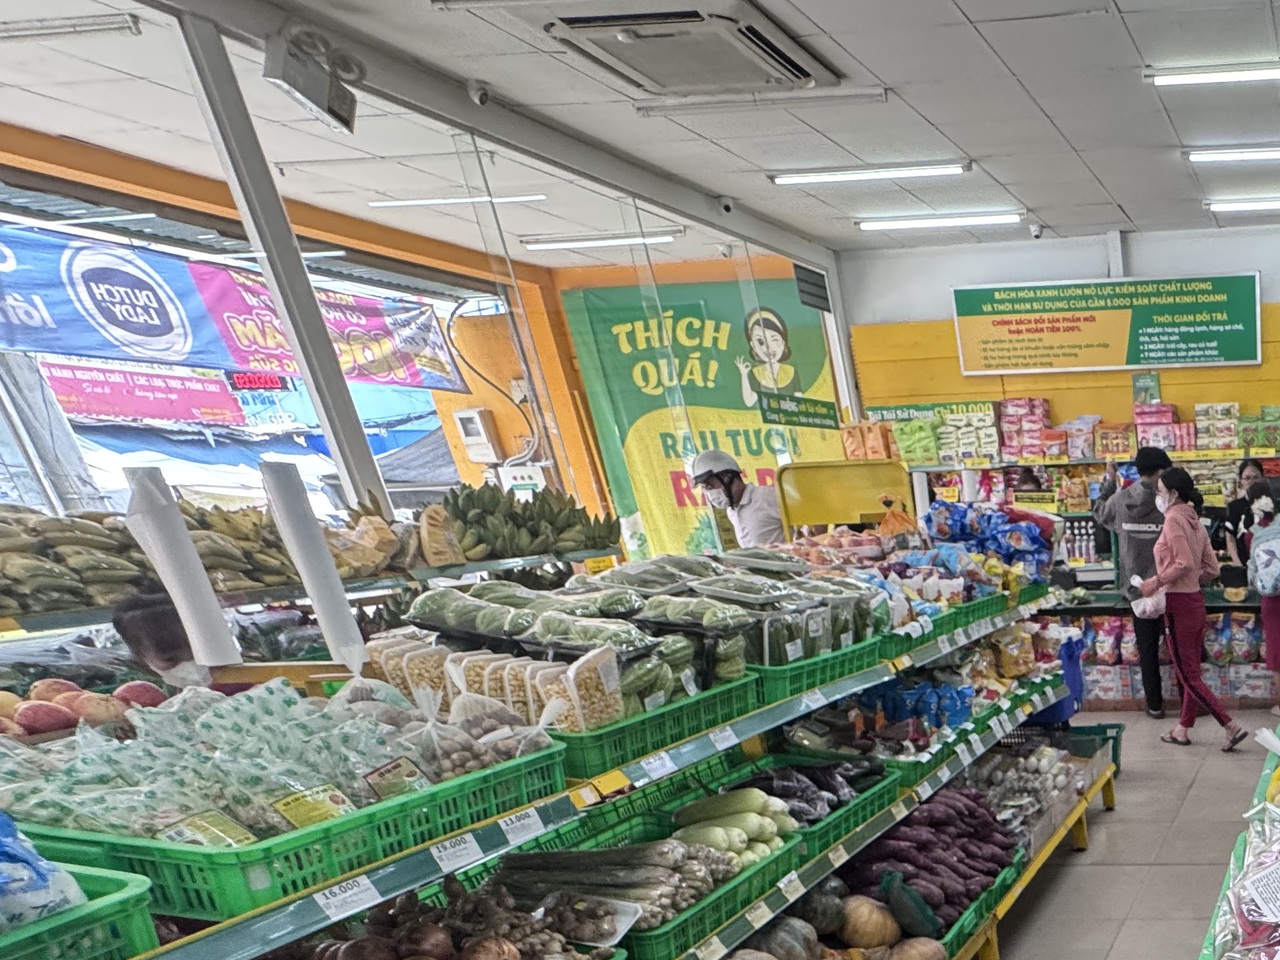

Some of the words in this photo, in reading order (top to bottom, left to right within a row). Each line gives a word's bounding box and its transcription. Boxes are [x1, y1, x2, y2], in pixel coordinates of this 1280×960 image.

[994, 289, 1016, 300] BÁCH
[1017, 287, 1035, 298] HÓA
[1036, 287, 1059, 297] XANH
[1060, 285, 1081, 296] LUÔN
[1098, 284, 1114, 295] LỰC
[1115, 283, 1136, 294] KIỂM
[1137, 282, 1157, 293] SOÁT
[1159, 281, 1181, 292] CHẤT
[1183, 281, 1212, 292] LƯỢNG
[982, 302, 994, 312] VÀ
[995, 301, 1013, 312] THỜI
[1014, 302, 1032, 313] HẠN
[1045, 300, 1068, 311] DỤNG
[1070, 298, 1086, 309] CỦA
[1132, 295, 1149, 306] SẢN
[1150, 293, 1174, 304] PHẨM
[1175, 294, 1196, 304] KINH
[1198, 293, 1227, 303] DOANH
[1152, 314, 1173, 323] THỜI
[1174, 314, 1195, 323] GIAN
[611, 309, 731, 354] THÍCH
[632, 351, 719, 396] QUÁ!
[435, 836, 467, 855] 19.000
[321, 880, 361, 901] 16.000
